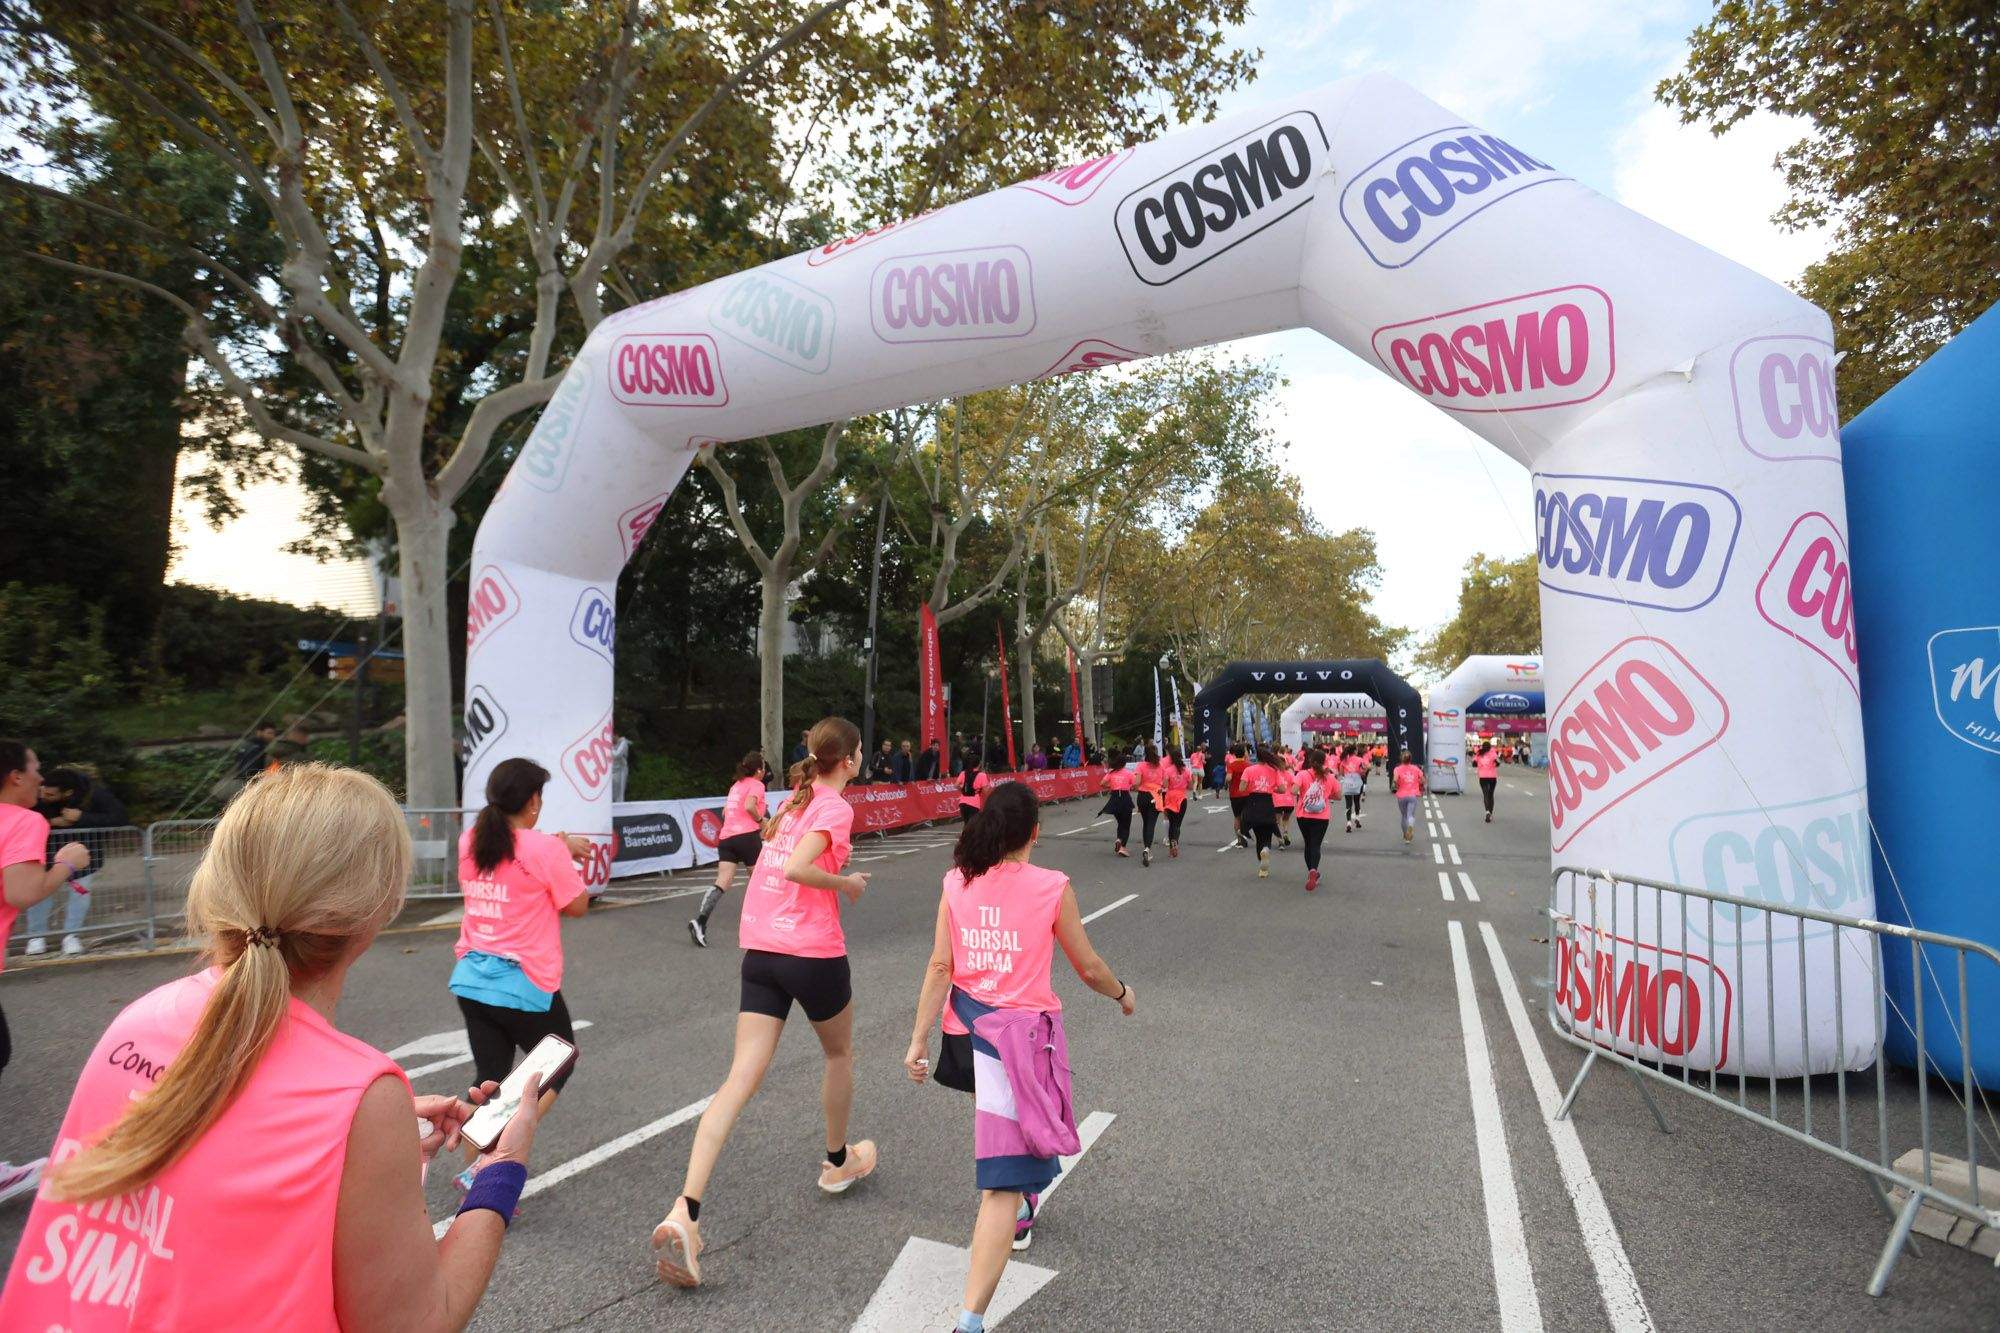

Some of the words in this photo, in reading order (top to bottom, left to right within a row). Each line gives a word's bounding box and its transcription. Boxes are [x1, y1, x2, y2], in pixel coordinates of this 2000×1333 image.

[1134, 125, 1311, 265] COSMO
[1363, 135, 1555, 243] COSM
[883, 259, 1020, 329] COSMO
[1390, 303, 1589, 398] COSMO
[618, 344, 715, 396] COSMO
[1251, 670, 1353, 682] VOLVO
[1320, 698, 1376, 710] OYSHO
[624, 833, 673, 848] Barcelona
[978, 905, 1001, 928] TU
[967, 951, 1013, 973] SUMA
